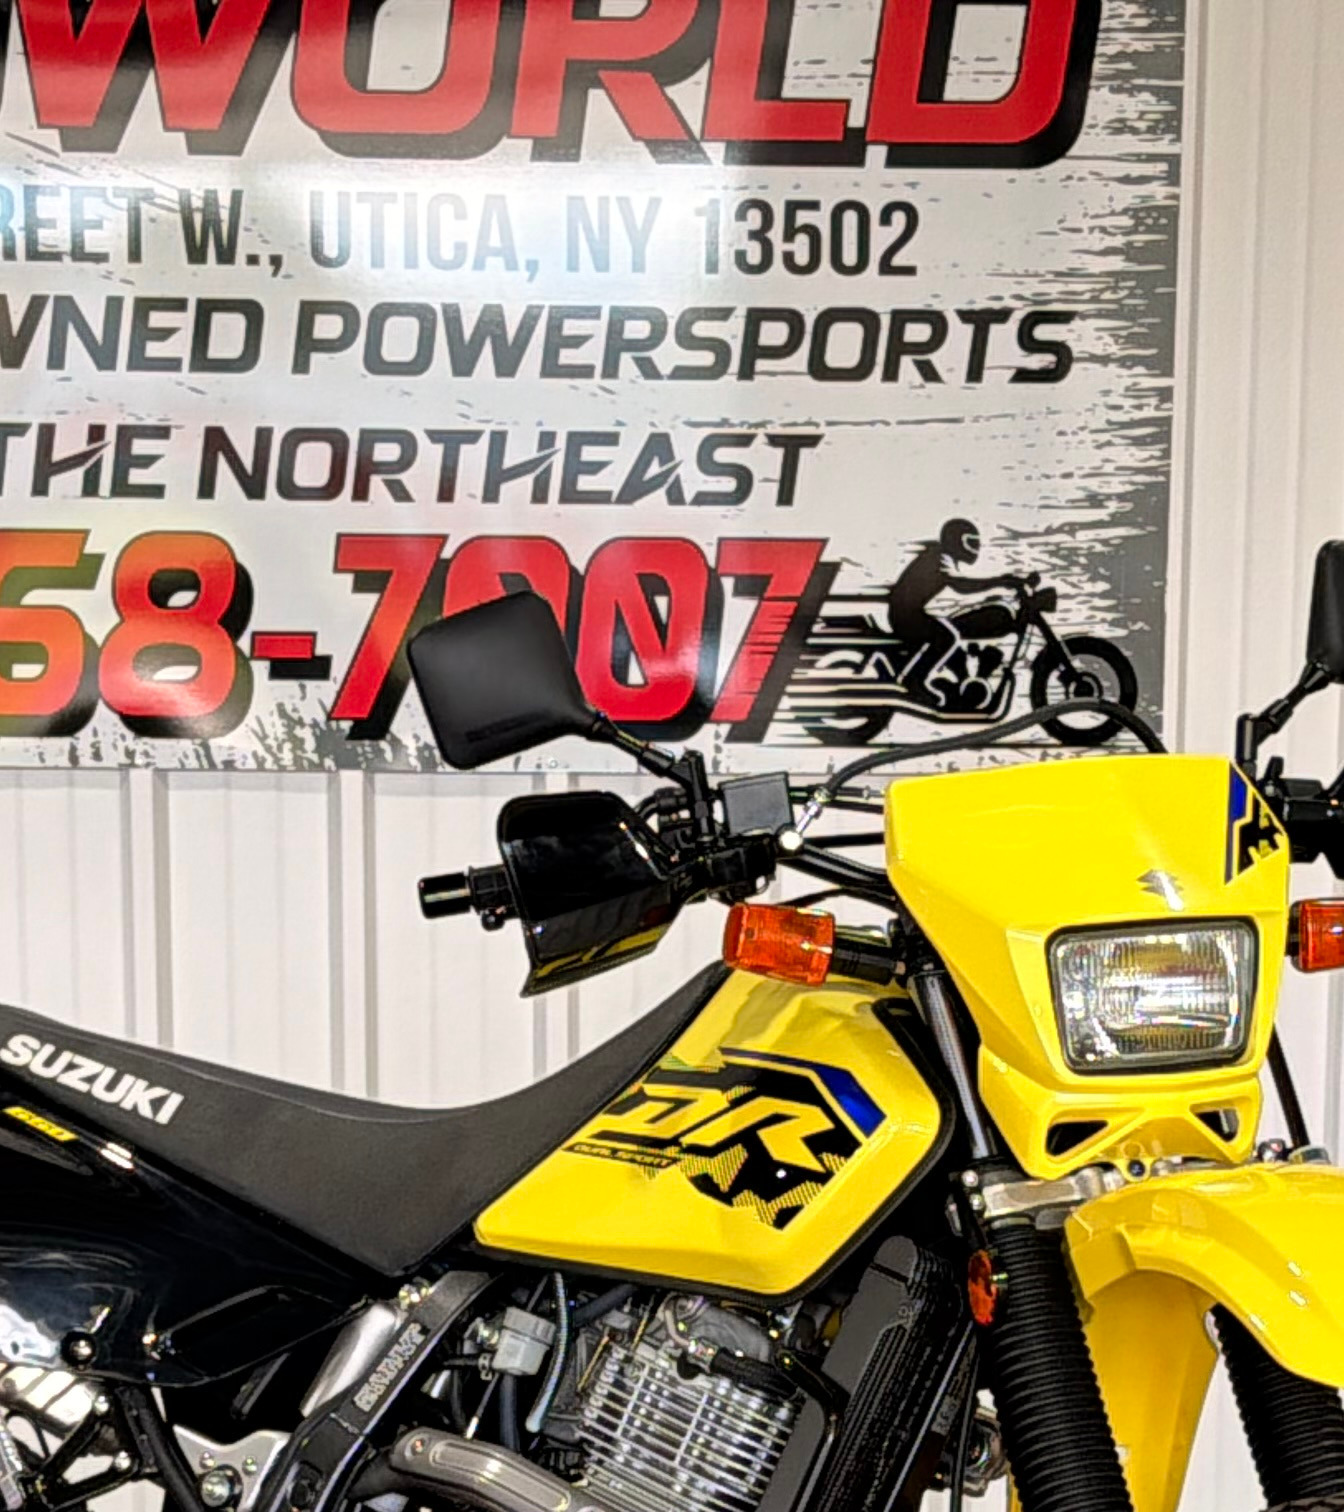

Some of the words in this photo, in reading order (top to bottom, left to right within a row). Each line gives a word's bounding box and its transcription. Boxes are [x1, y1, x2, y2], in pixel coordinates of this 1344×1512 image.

[178, 188, 284, 278] W.,
[308, 190, 539, 282] UTICA,
[566, 194, 662, 275] NY
[693, 198, 920, 277] 13502
[289, 300, 1084, 385] POWERSPORTS
[196, 424, 827, 508] NORTHEAST
